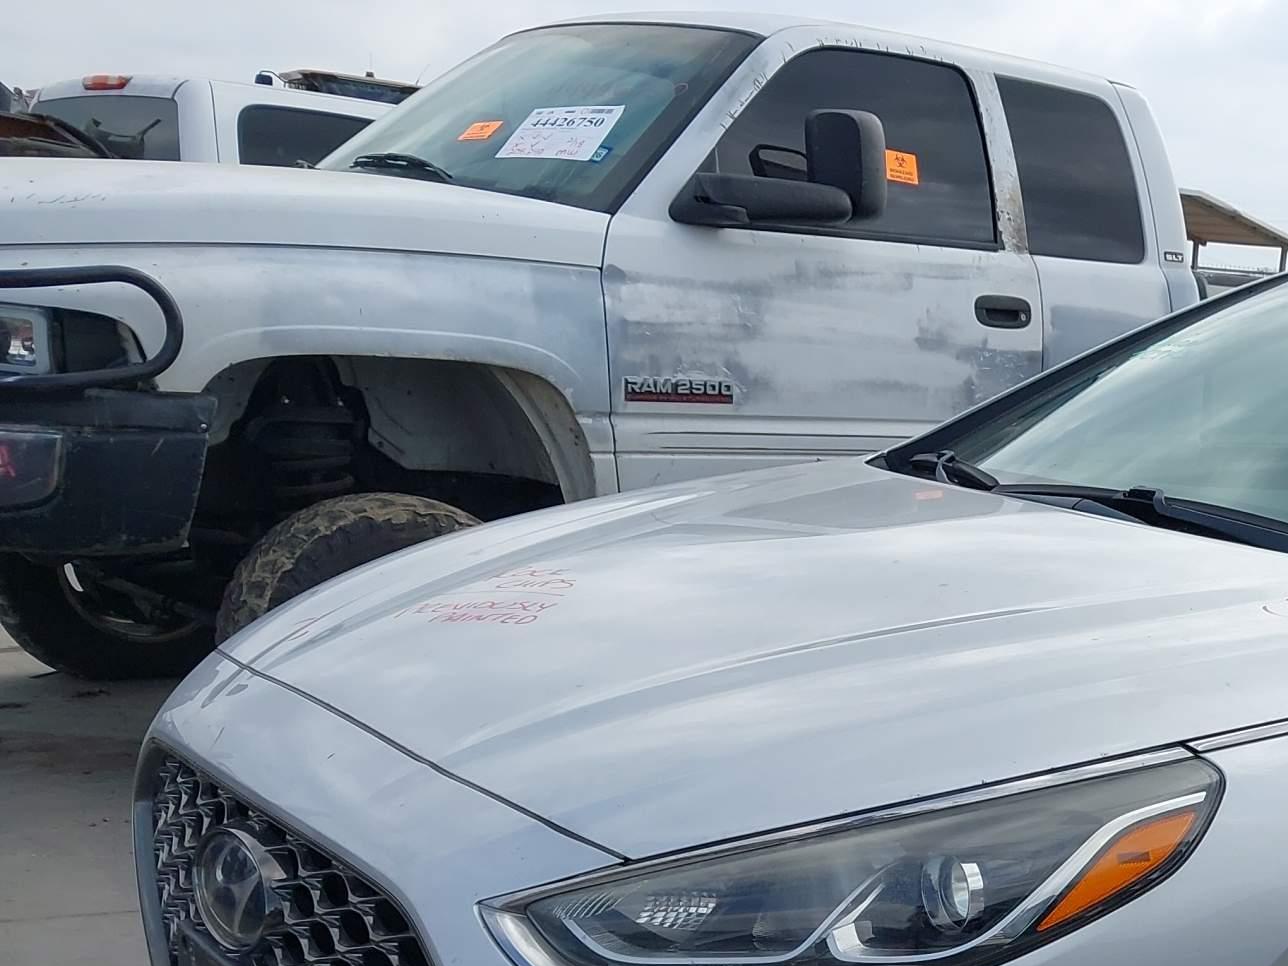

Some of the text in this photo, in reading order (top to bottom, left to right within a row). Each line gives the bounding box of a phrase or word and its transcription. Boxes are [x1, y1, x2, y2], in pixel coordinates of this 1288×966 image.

[531, 117, 606, 128] 44426750
[623, 376, 733, 396] RAM 2500
